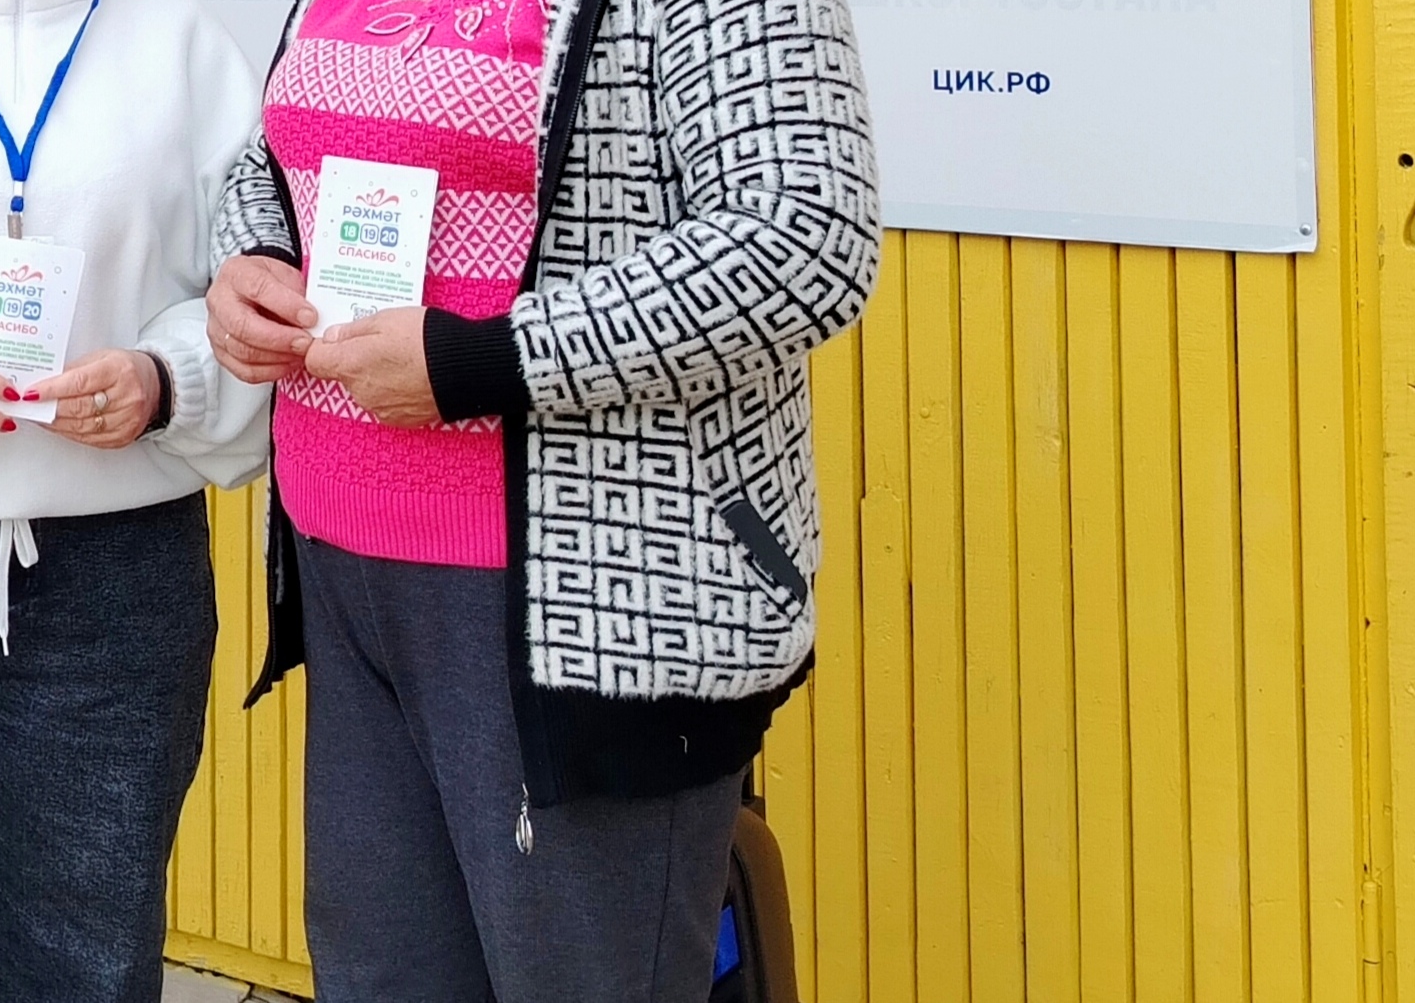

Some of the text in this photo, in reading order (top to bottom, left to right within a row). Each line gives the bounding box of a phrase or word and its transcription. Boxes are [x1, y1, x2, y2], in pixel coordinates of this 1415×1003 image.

[933, 69, 1052, 95] ЦИК.РФ
[343, 225, 397, 243] 18 19 20
[338, 246, 396, 263] СПАСИБО
[7, 302, 19, 313] 19
[25, 304, 40, 318] 20
